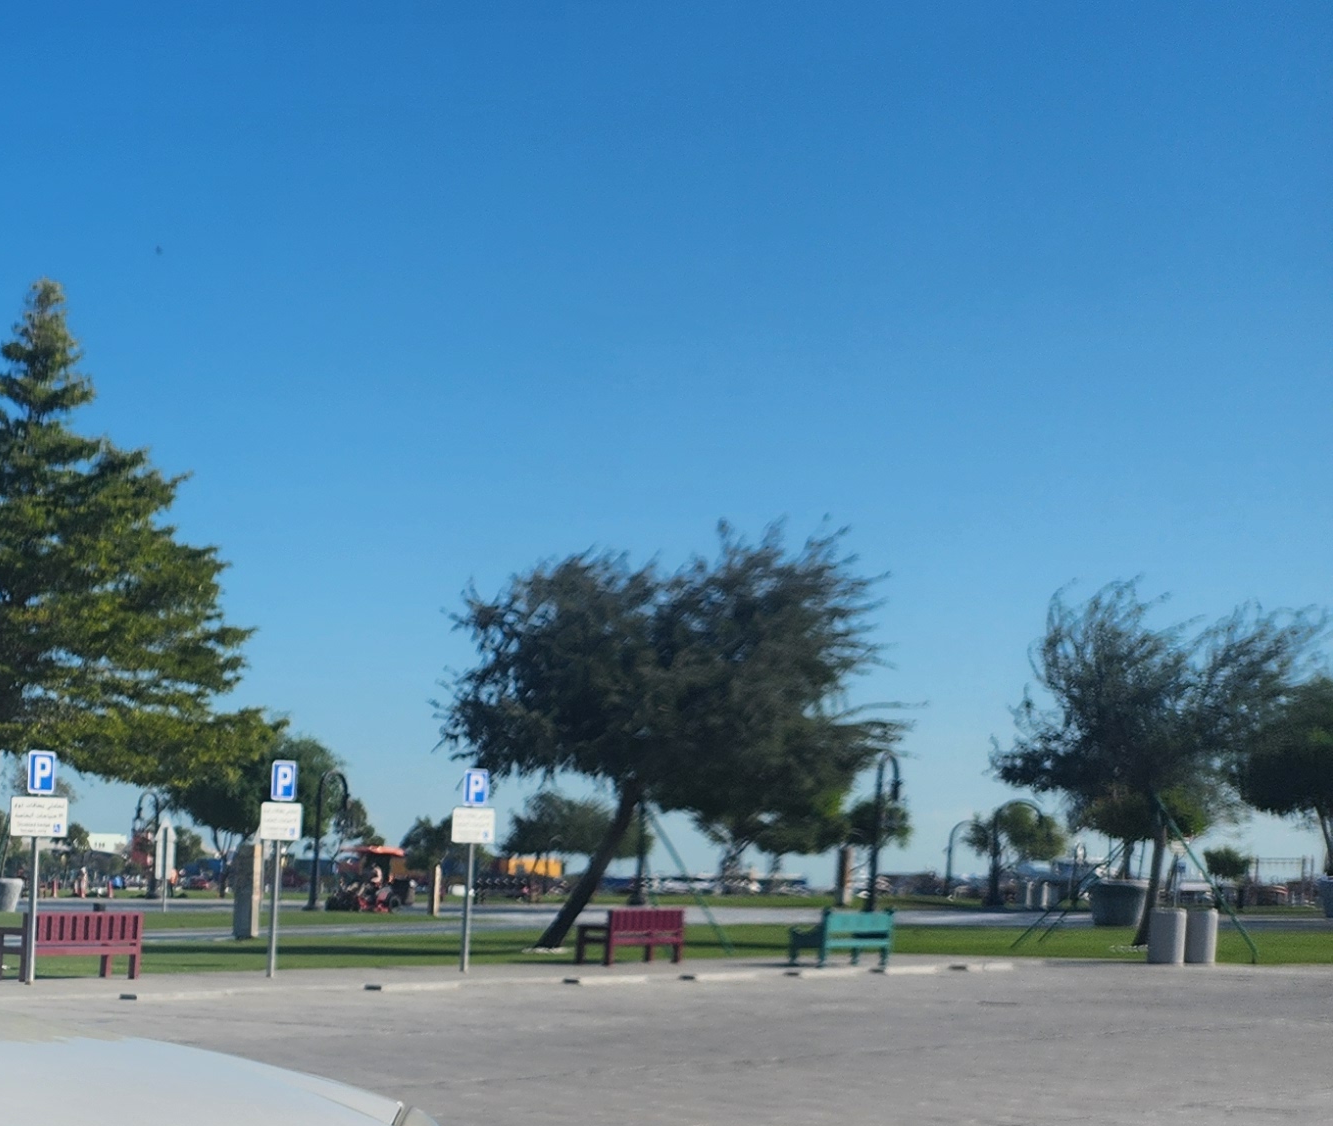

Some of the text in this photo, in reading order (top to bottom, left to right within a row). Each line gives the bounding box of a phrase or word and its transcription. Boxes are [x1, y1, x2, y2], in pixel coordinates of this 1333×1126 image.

[34, 755, 52, 789] P
[276, 765, 293, 797] P
[469, 774, 485, 803] P
